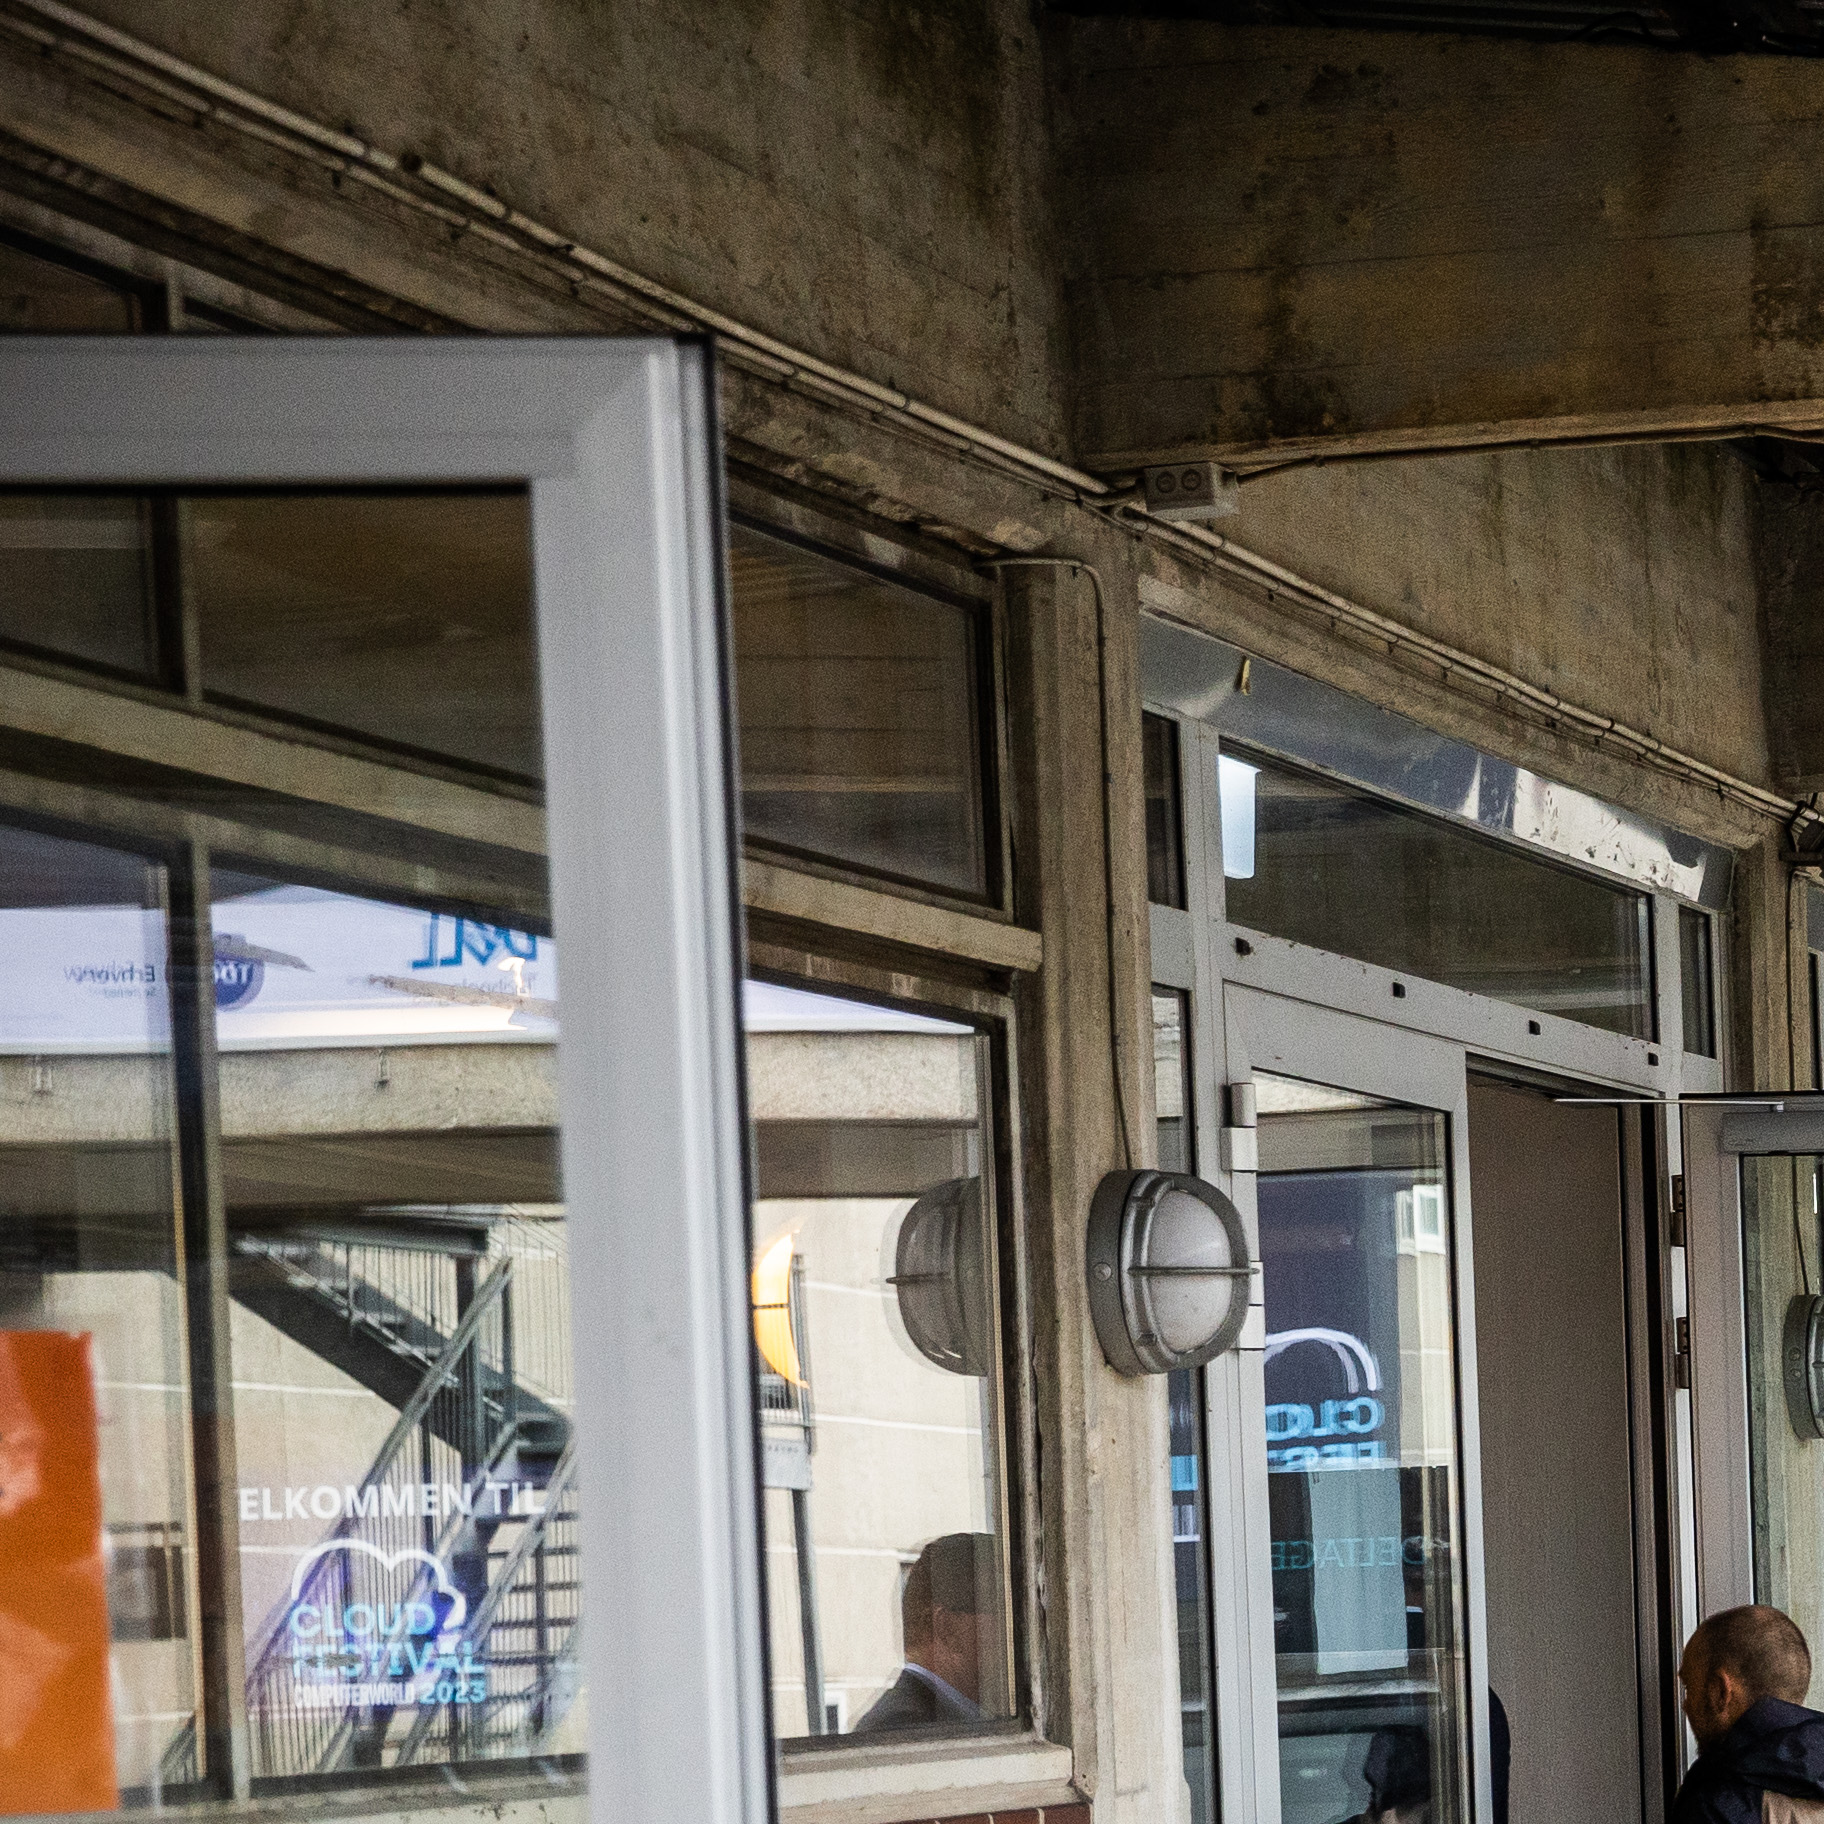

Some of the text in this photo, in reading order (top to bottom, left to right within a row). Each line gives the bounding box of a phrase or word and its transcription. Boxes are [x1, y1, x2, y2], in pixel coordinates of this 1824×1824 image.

[239, 1481, 547, 1522] ELKOMMEN TIL
[289, 1603, 436, 1638] CLOUD
[291, 1640, 486, 1678] FESTIVAL
[419, 1678, 487, 1705] 2023
